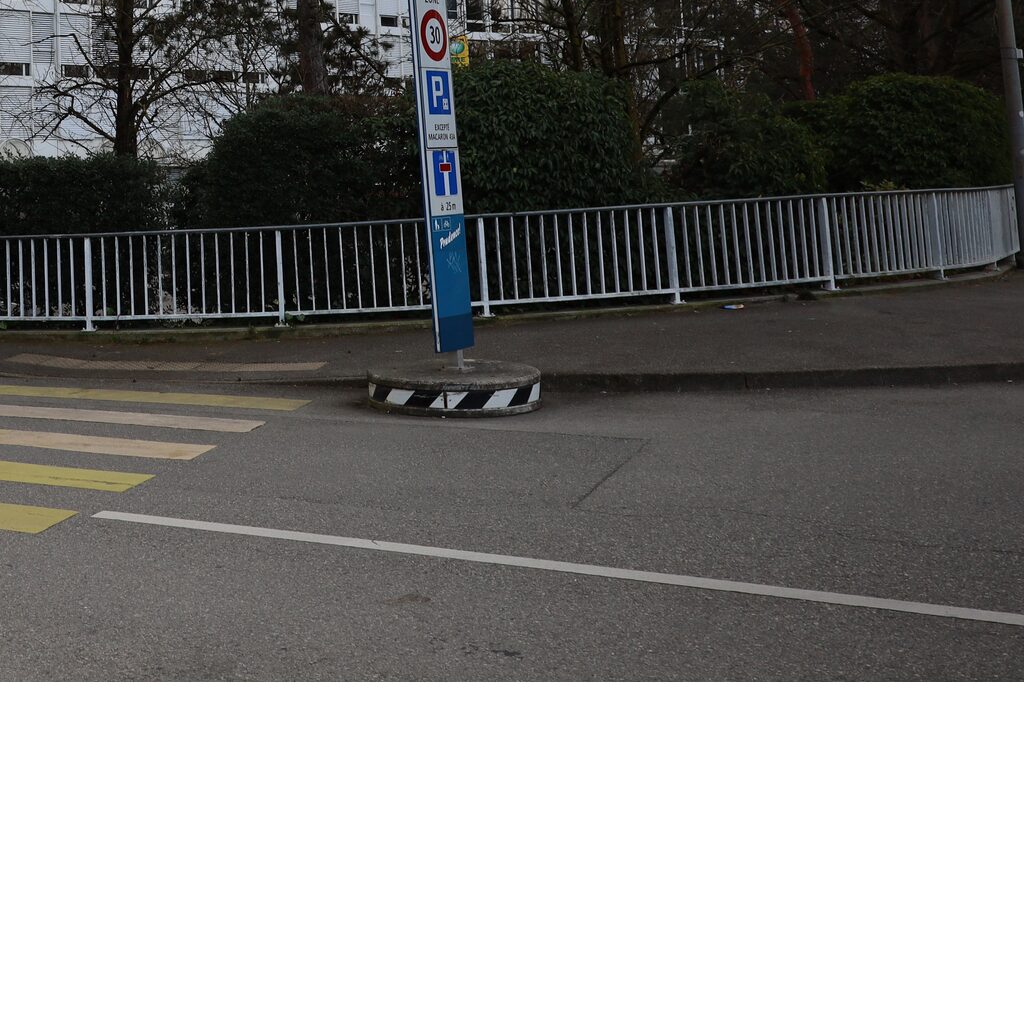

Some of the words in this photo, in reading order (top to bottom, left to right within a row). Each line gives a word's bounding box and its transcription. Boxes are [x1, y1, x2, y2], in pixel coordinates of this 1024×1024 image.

[429, 25, 441, 45] 30
[431, 76, 444, 108] P
[428, 133, 448, 141] MACARON
